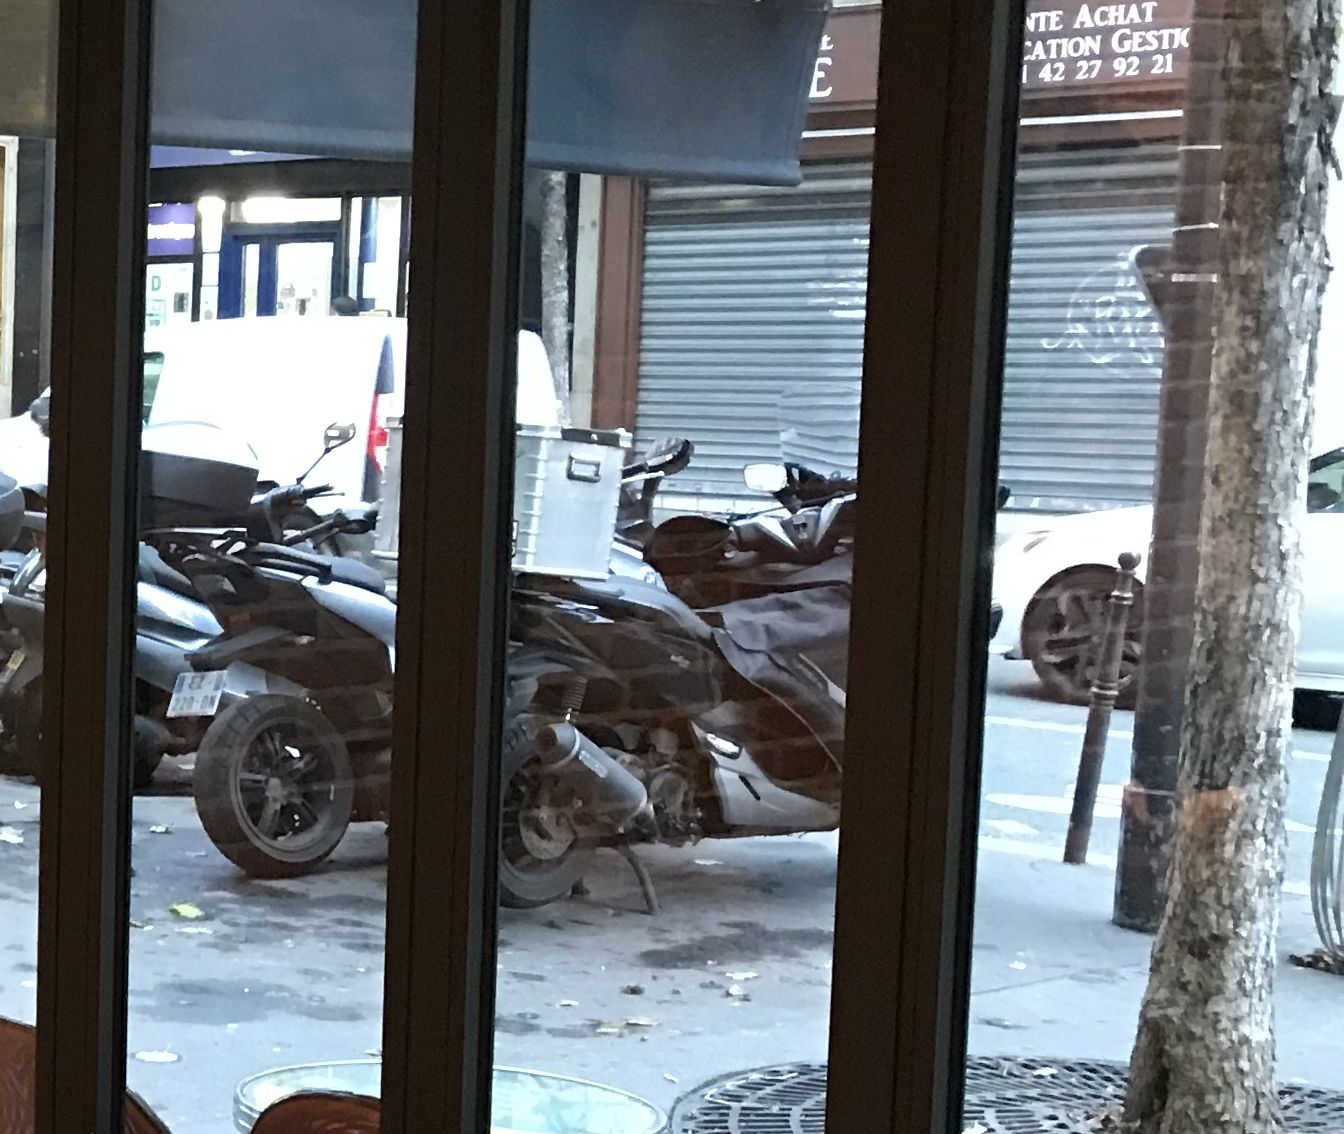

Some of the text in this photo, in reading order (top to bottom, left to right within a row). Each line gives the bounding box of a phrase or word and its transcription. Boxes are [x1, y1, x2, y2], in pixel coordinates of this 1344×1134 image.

[1073, 2, 1158, 28] ACHAT
[1038, 62, 1066, 83] 42
[1075, 60, 1103, 80] 27
[1112, 56, 1140, 78] 92
[1150, 53, 1174, 74] 21
